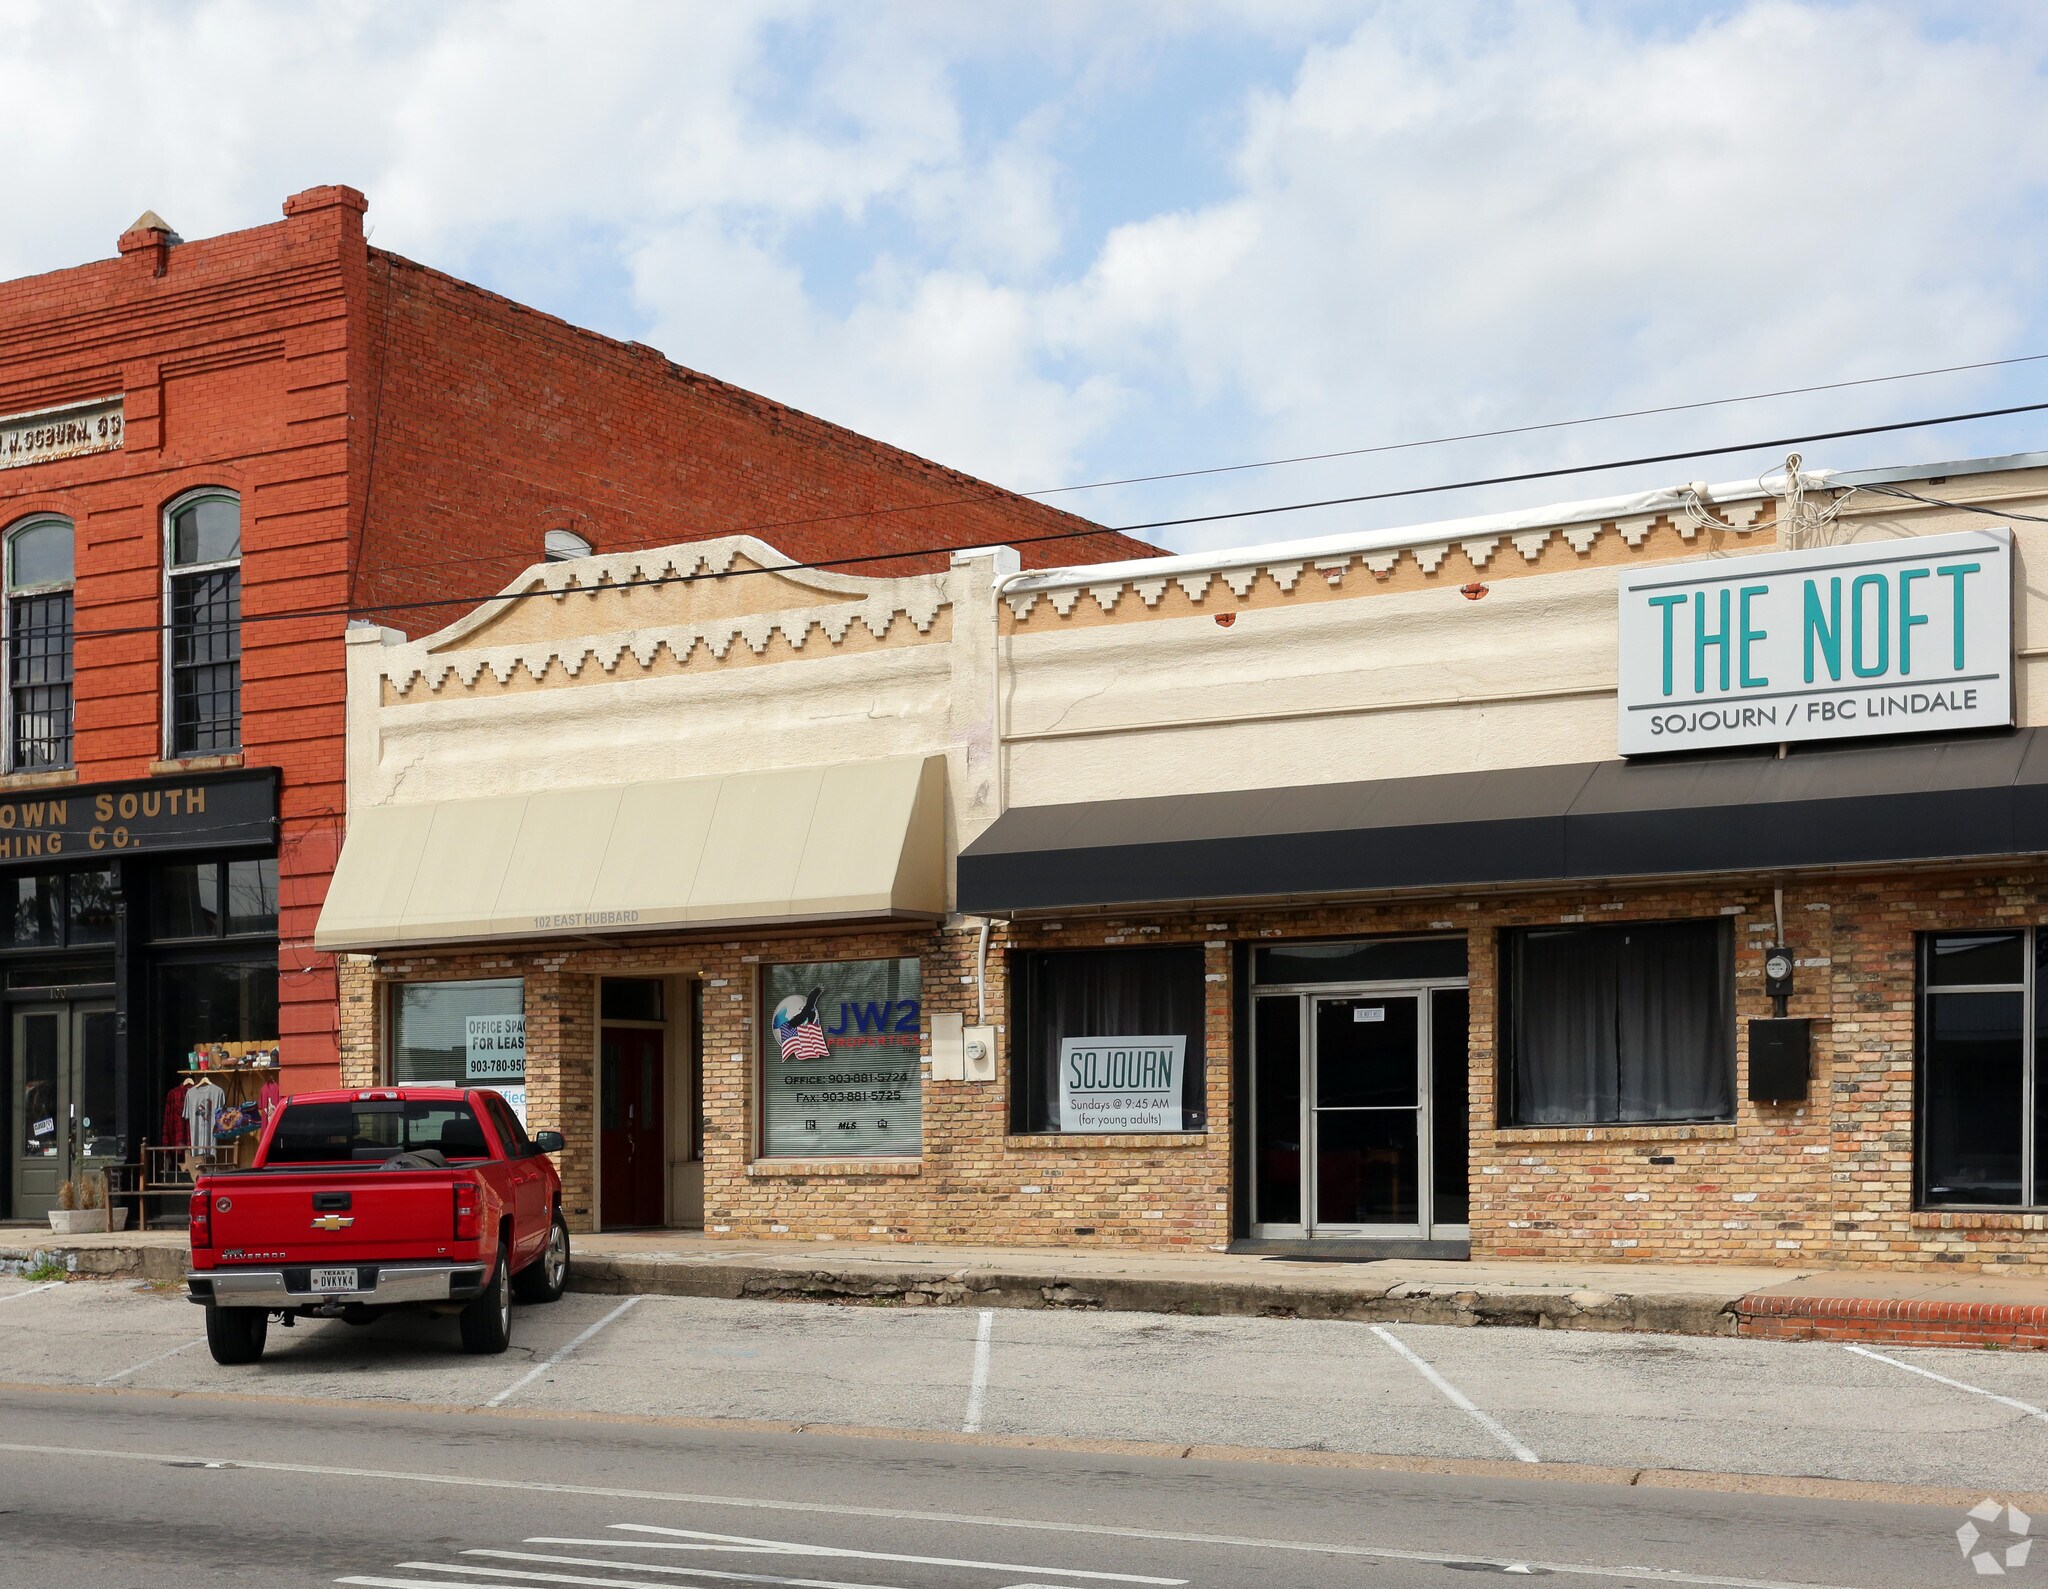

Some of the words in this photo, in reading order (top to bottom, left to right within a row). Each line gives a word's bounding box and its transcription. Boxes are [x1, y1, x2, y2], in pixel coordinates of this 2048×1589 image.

[1648, 584, 1769, 696] THE
[1803, 562, 1981, 683] NOFT
[1650, 705, 1777, 735] SOJOURN
[1785, 703, 1799, 726] /
[1807, 699, 1857, 722] FBC
[1867, 688, 1978, 717] LINDALE
[95, 787, 206, 822] SOUTH
[89, 826, 140, 849] CO.
[534, 916, 550, 928] 102
[554, 913, 582, 927] EAST
[585, 910, 639, 925] HUBBARD
[828, 1000, 920, 1035] JW2
[469, 1020, 502, 1034] OFFICE
[472, 1036, 494, 1050] FOR
[826, 1035, 921, 1048] PROPERTIES
[1069, 1050, 1173, 1089] SOJOURN
[785, 1075, 825, 1085] OFFICE:
[828, 1073, 908, 1083] 903-881-5724
[796, 1093, 819, 1102] FAX:
[822, 1091, 901, 1102] 903-881-5725
[1071, 1098, 1110, 1112] Sundays
[1112, 1099, 1122, 1109] @
[1125, 1099, 1148, 1109] 9:45
[1151, 1098, 1170, 1109] AM
[838, 1122, 857, 1130] MLS
[1078, 1112, 1095, 1127] (for
[1096, 1115, 1128, 1127] young
[1130, 1112, 1161, 1126] adults)
[222, 1252, 286, 1260] SILVERADO
